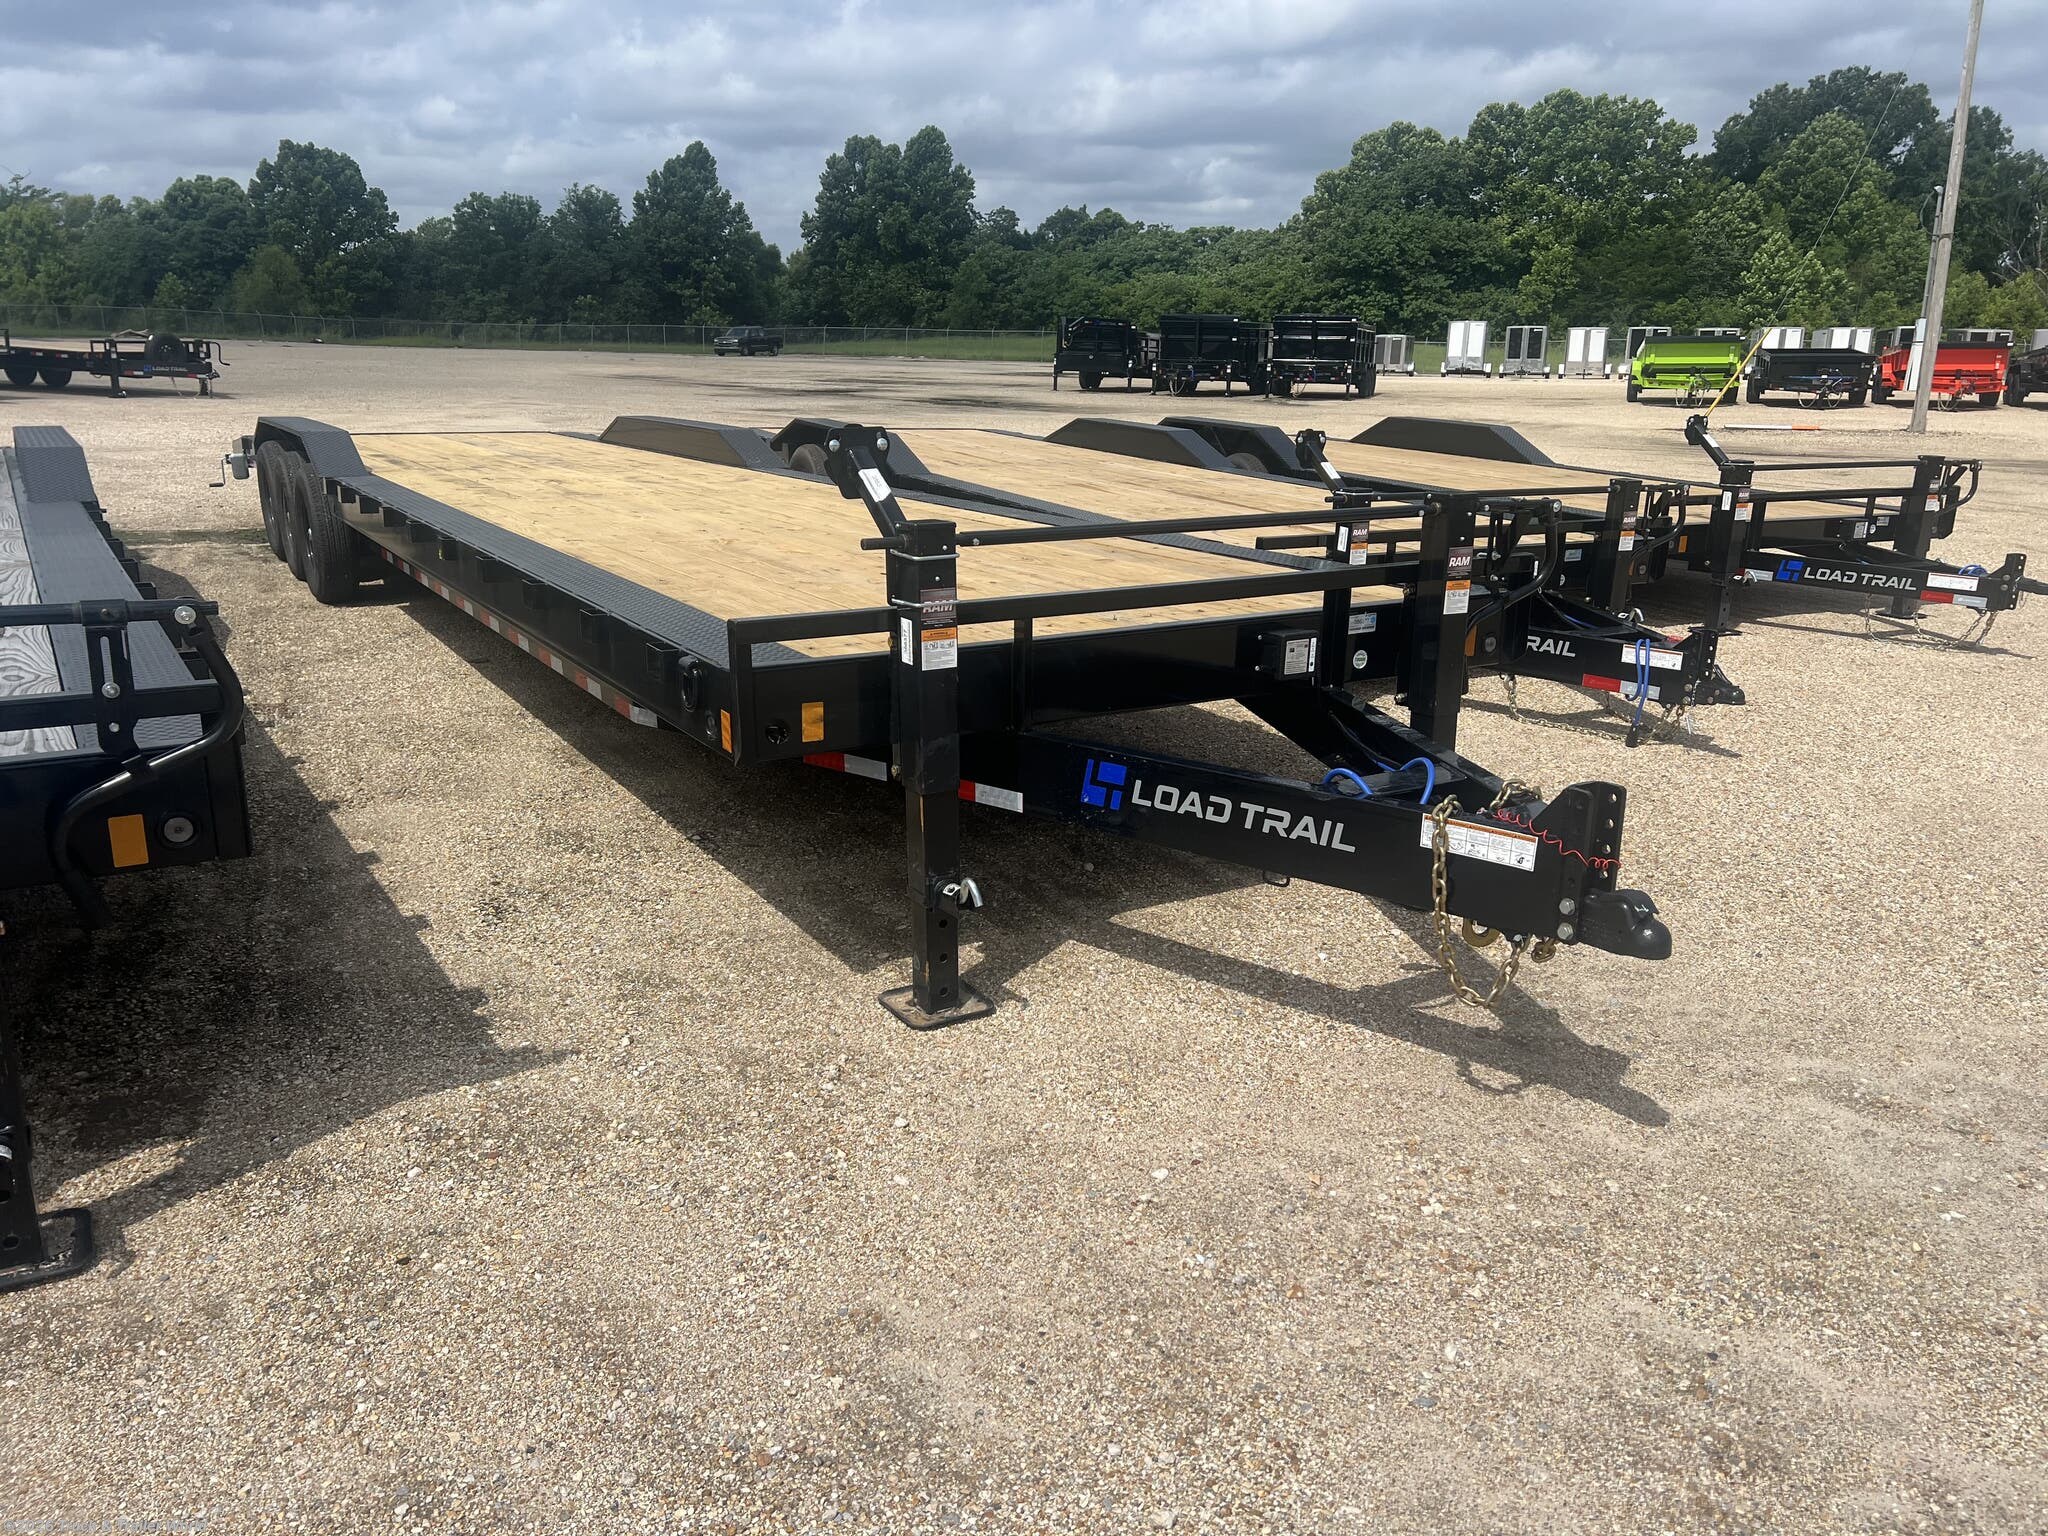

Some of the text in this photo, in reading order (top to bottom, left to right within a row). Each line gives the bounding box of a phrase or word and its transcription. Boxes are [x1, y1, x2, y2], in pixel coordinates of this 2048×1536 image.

[1449, 556, 1471, 567] RAM
[1803, 567, 1858, 584] LOAD
[1861, 573, 1917, 591] TRAIL
[923, 599, 954, 614] RAM
[1526, 635, 1576, 657] RAIL
[1131, 779, 1356, 853] LOAD TRAIL
